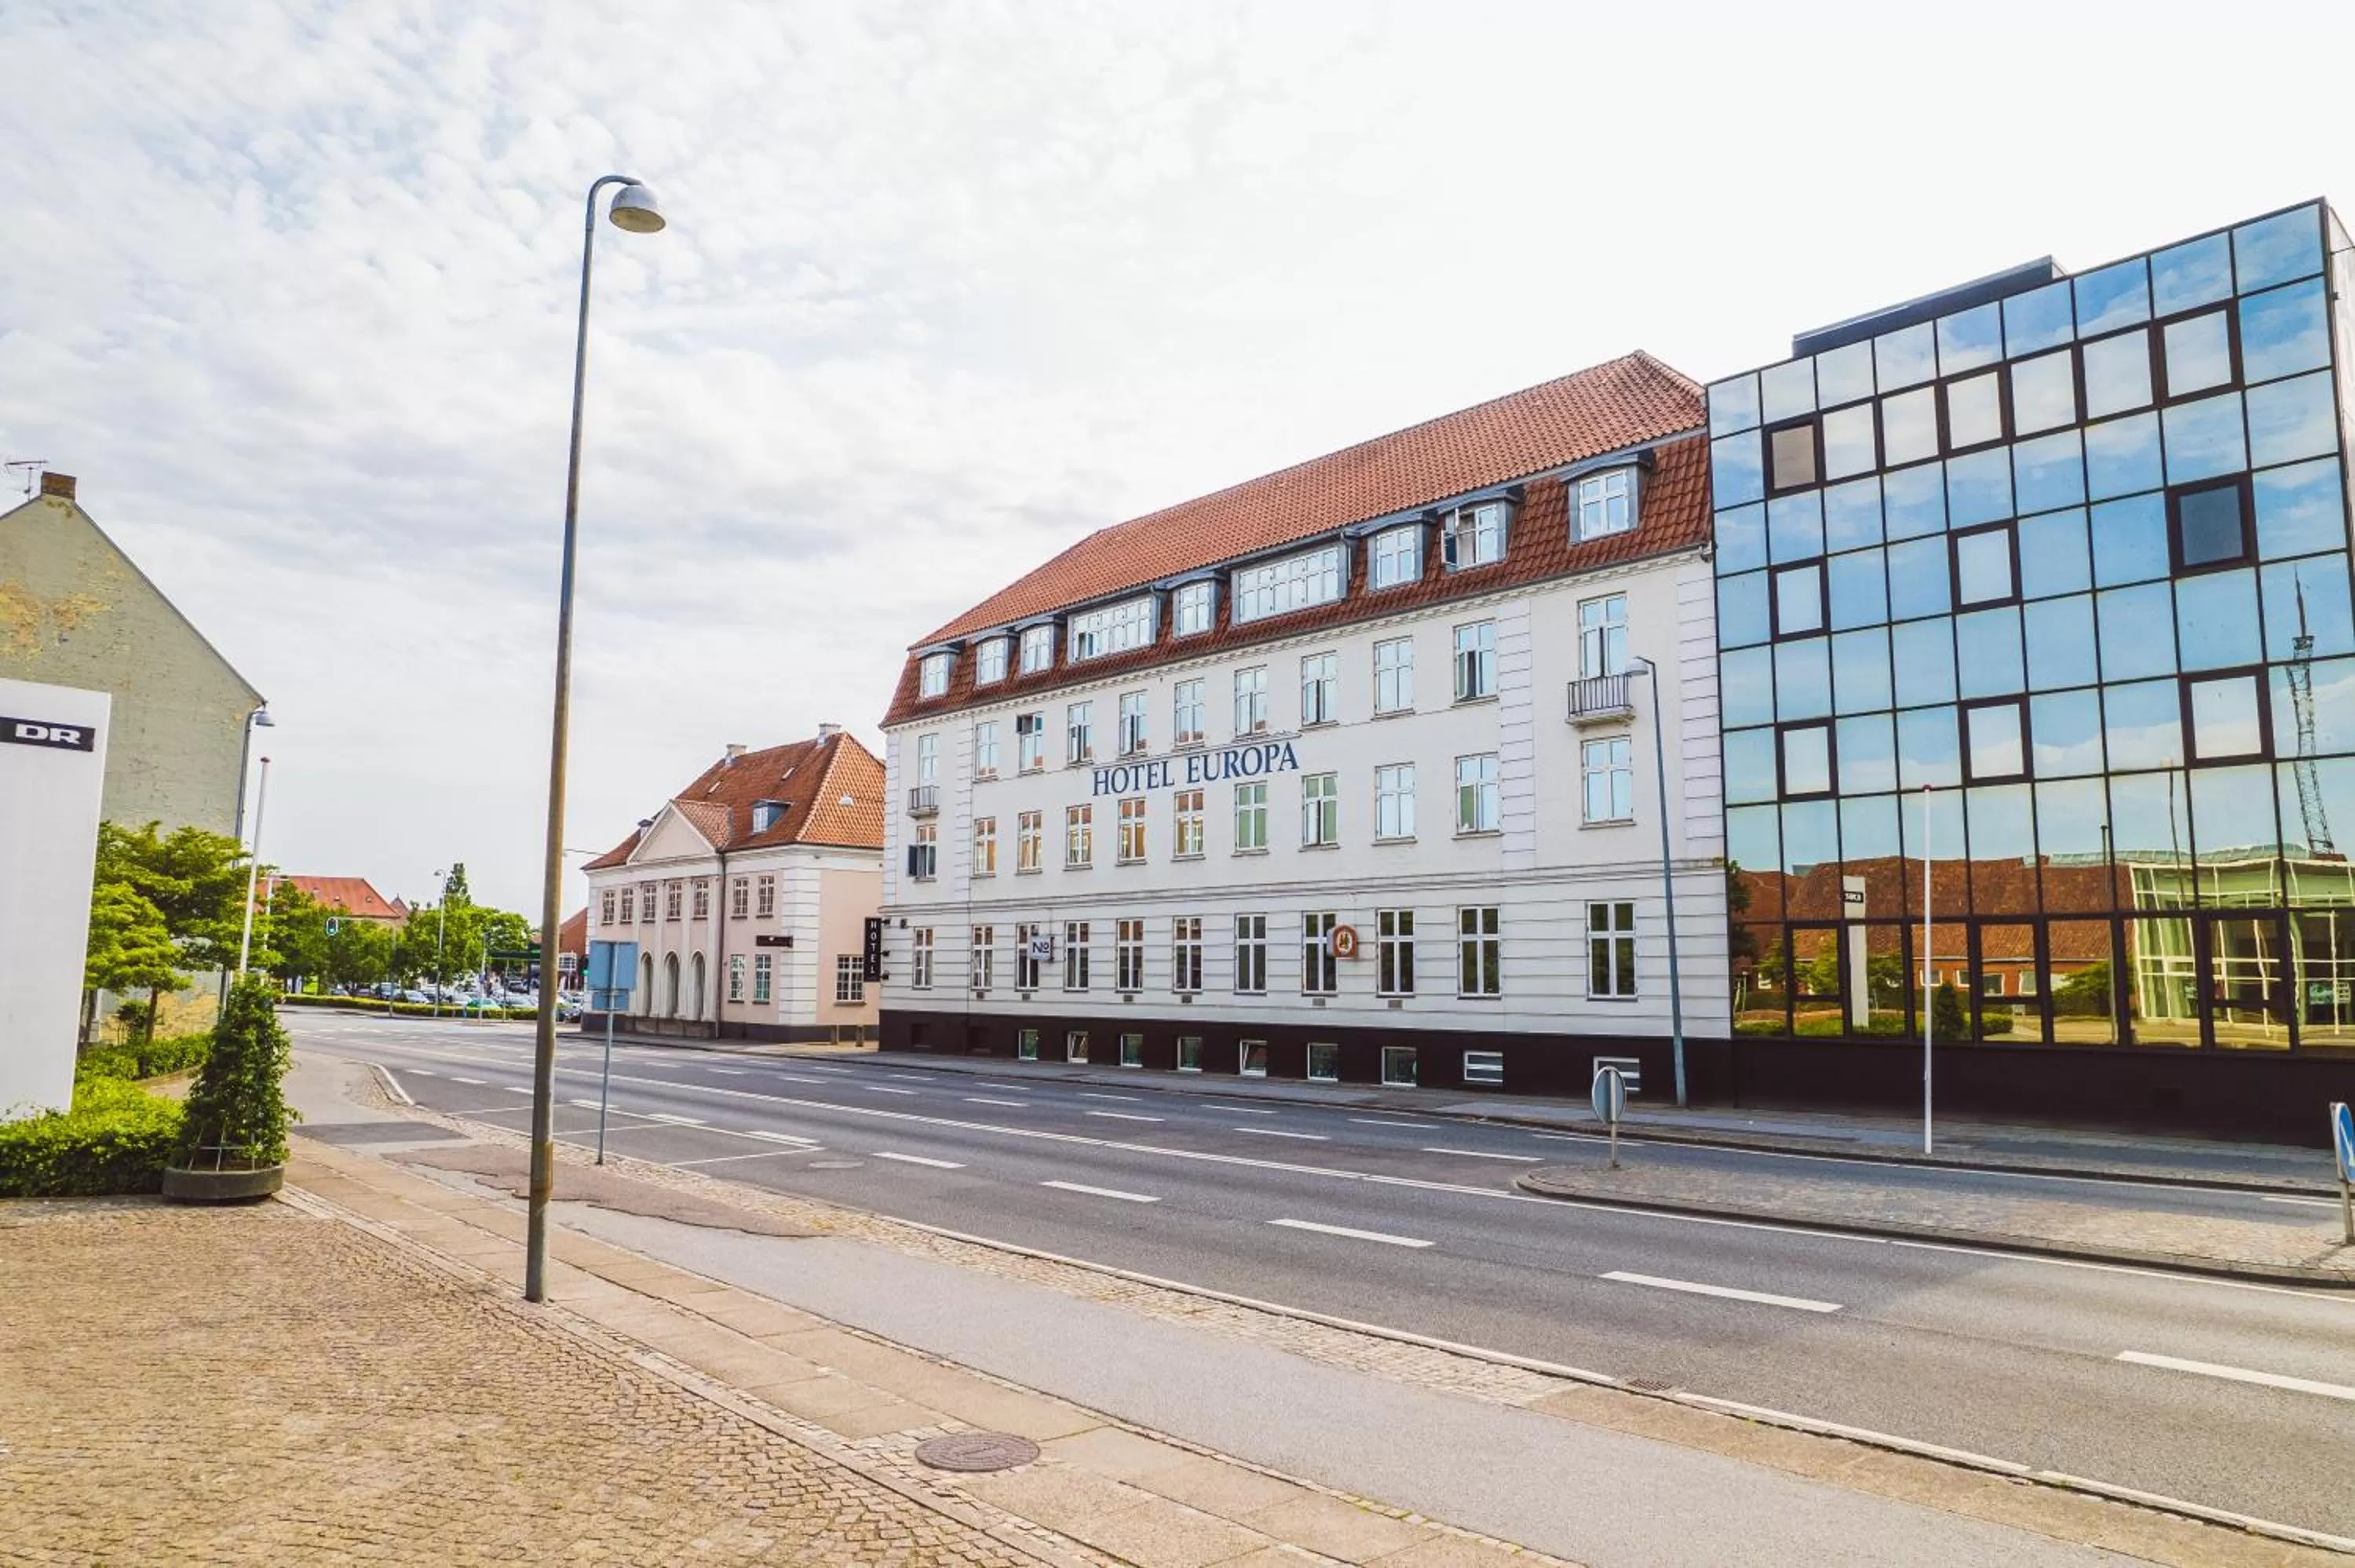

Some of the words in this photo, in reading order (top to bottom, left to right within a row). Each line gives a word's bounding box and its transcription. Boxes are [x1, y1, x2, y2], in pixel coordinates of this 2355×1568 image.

[16, 723, 81, 745] DR
[1092, 760, 1175, 796] HOTEL
[1186, 741, 1299, 784] EUROPA
